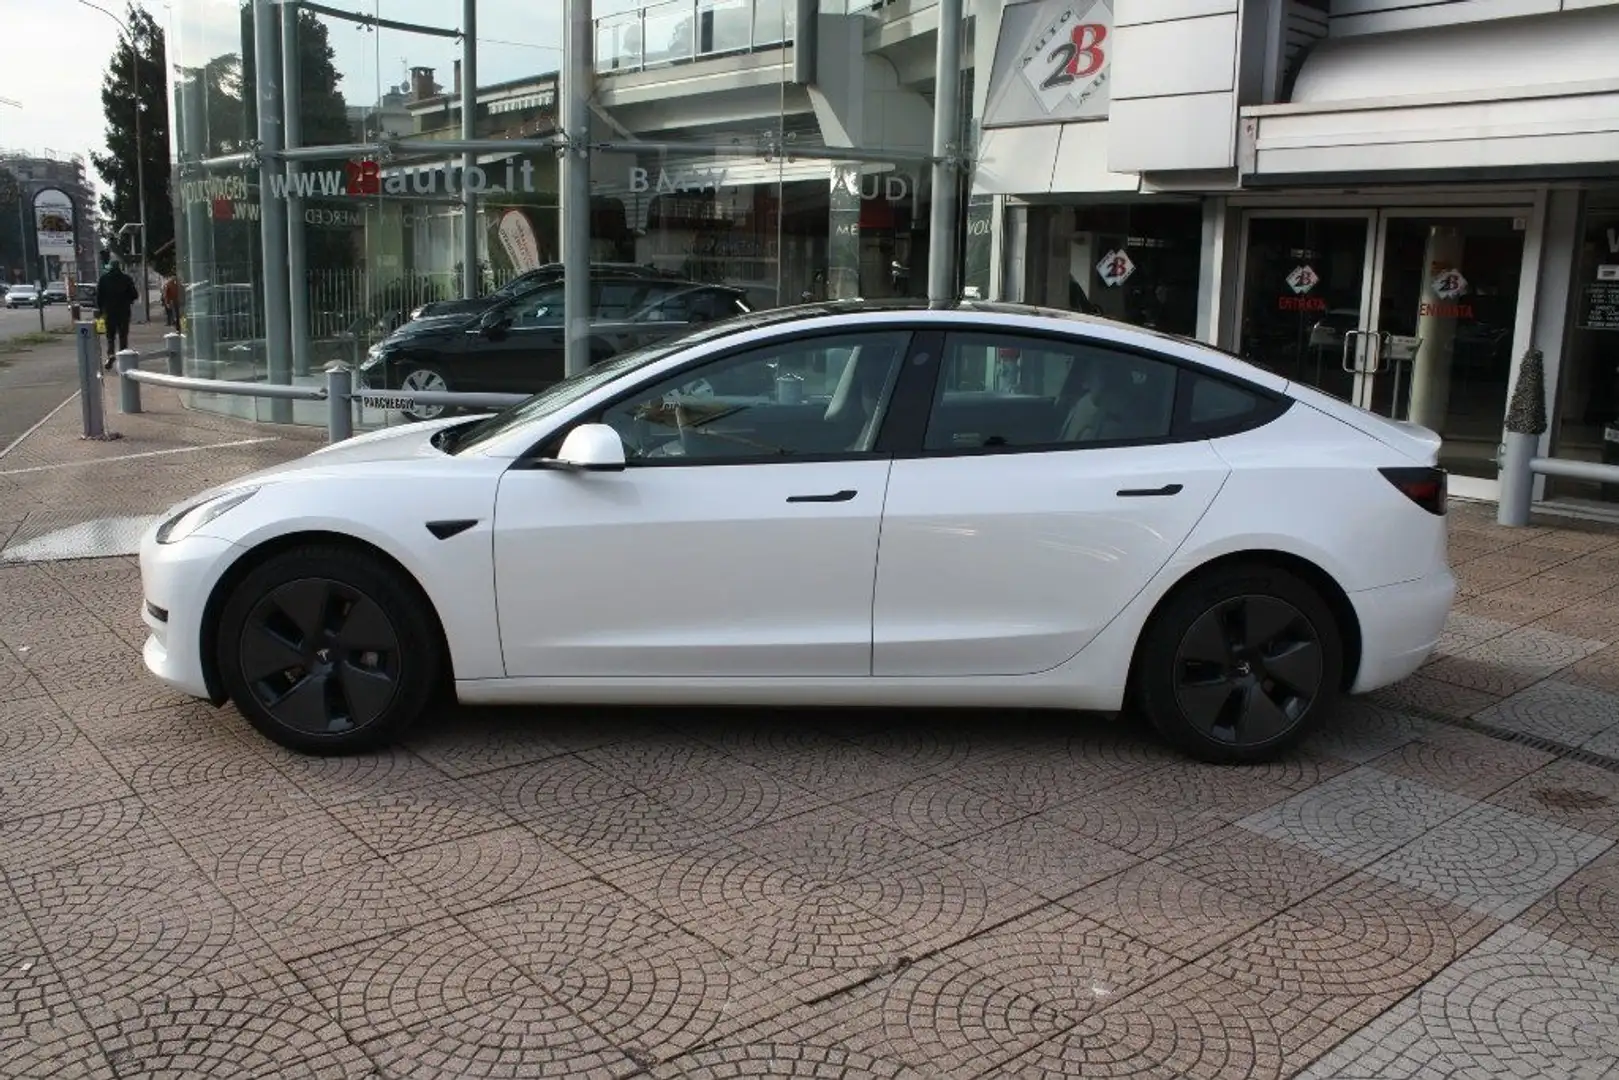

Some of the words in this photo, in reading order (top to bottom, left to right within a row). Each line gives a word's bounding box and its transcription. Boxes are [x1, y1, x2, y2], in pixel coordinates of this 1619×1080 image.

[1039, 24, 1107, 91] 2B
[629, 166, 728, 193] BMW
[830, 166, 917, 205] AUDI
